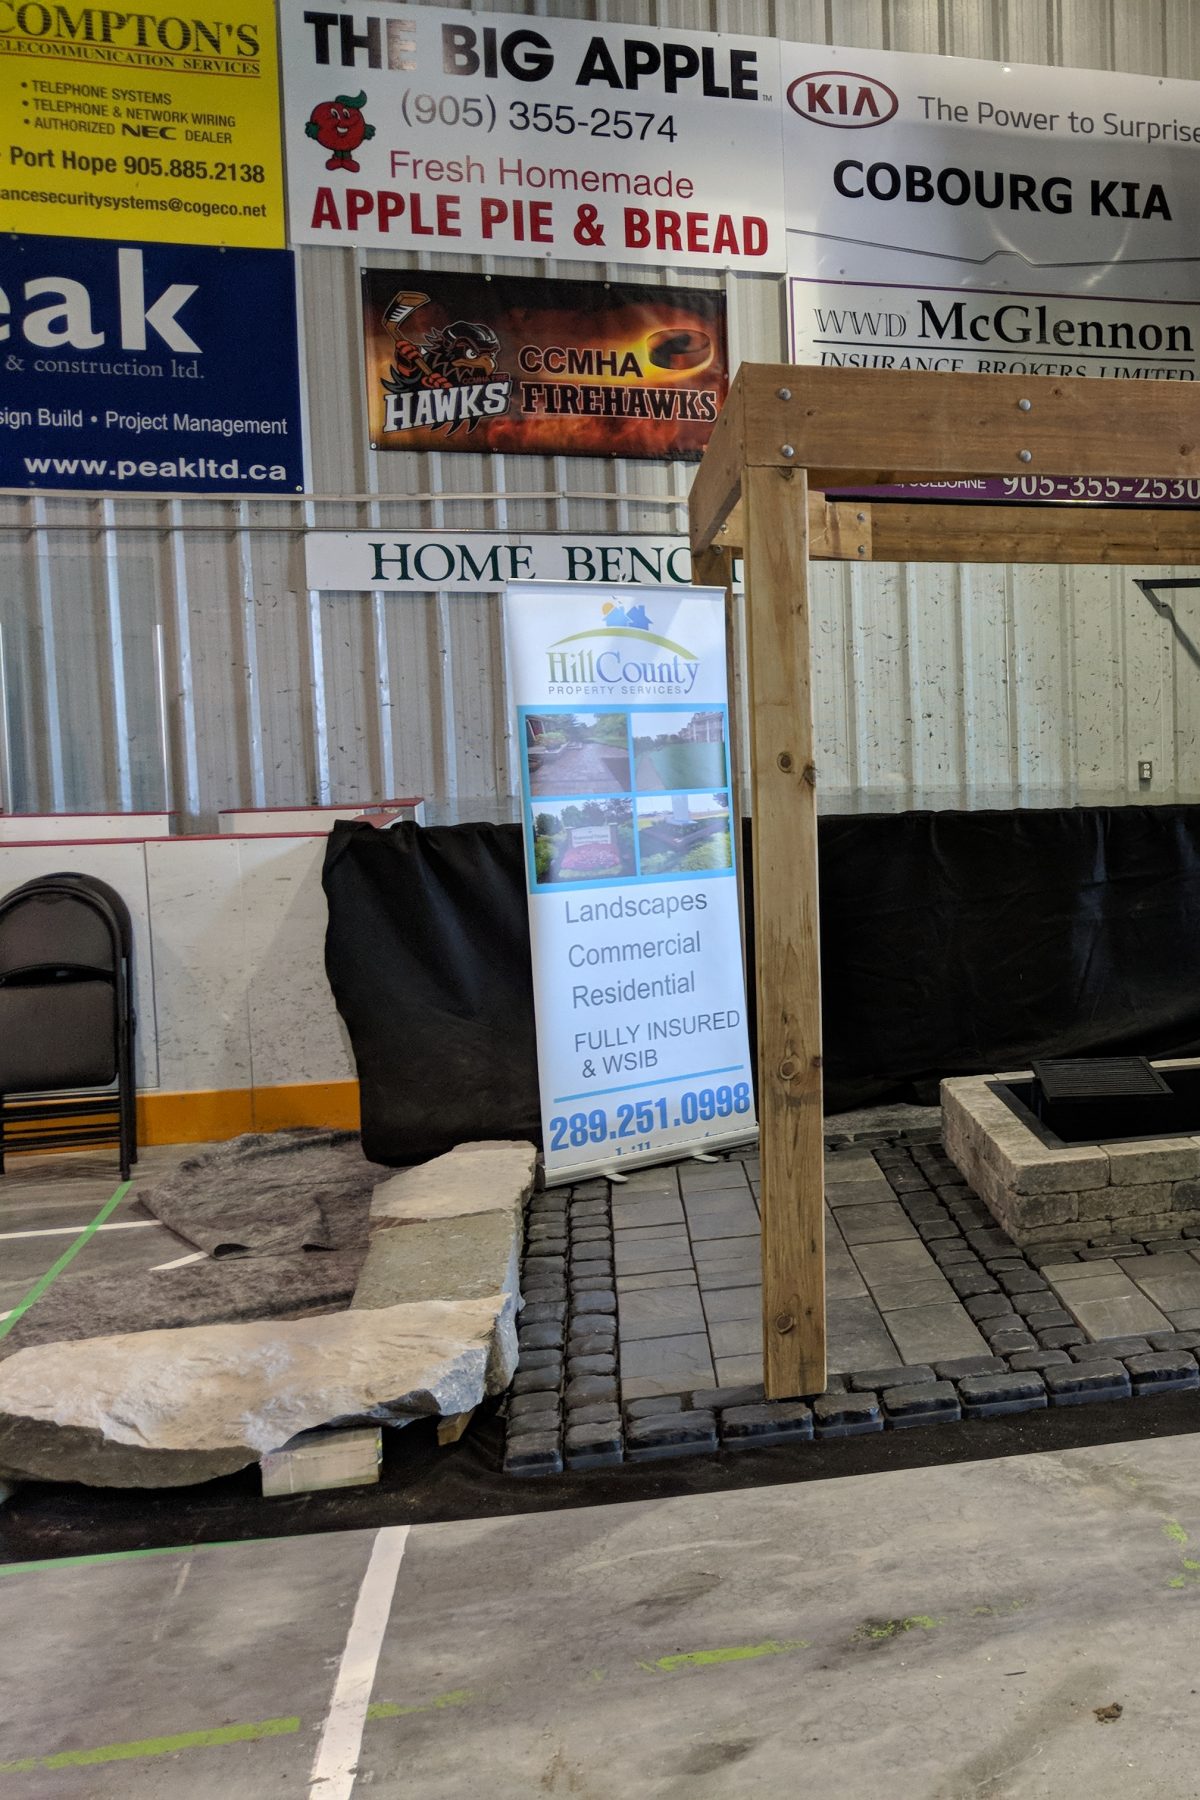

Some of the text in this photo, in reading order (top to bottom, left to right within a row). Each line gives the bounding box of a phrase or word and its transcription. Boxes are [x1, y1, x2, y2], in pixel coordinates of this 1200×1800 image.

[0, 39, 260, 75] LECOMMUNICATION SERVICES
[303, 10, 416, 71] THE
[441, 23, 554, 83] BIG
[575, 36, 759, 101] APPLE
[32, 80, 172, 105] TELEPHONE SYSTEMS
[805, 82, 880, 118] KIA
[33, 98, 236, 128] TELEPHONE & NETWORK WIRING
[34, 117, 233, 144] AUTHORIZED NEC DEALER
[401, 88, 678, 143] (905) 355-2574
[917, 96, 969, 123] The
[977, 102, 1060, 132] Power
[1067, 111, 1095, 133] to
[10, 146, 265, 183] Port Hope 905.885.2138
[390, 150, 694, 199] Fresh Homemade
[833, 159, 1173, 221] COBOURG KIA
[311, 187, 768, 256] APPLE PIE & BREAD
[0, 248, 203, 353] ak
[916, 300, 1195, 352] McGlennon
[5, 355, 205, 378] & construction ltd.
[517, 345, 644, 378] CCMHA
[383, 381, 512, 432] HAWKS
[520, 381, 717, 422] FIREHAWKS
[38, 408, 83, 427] Build
[106, 411, 168, 433] Project
[174, 413, 288, 437] Management
[24, 457, 287, 481] www.peakltd.ca
[368, 543, 536, 582] HOME
[546, 650, 699, 695] HillCounty
[548, 686, 682, 695] PROPERTY SERVICES
[565, 892, 708, 924] Landscapes
[568, 931, 701, 968] Commercial
[572, 971, 695, 1009] Residential
[574, 1010, 741, 1052] FULLY INSURED
[582, 1049, 658, 1078] & WSIB
[549, 1082, 751, 1152] 289.251.0998
